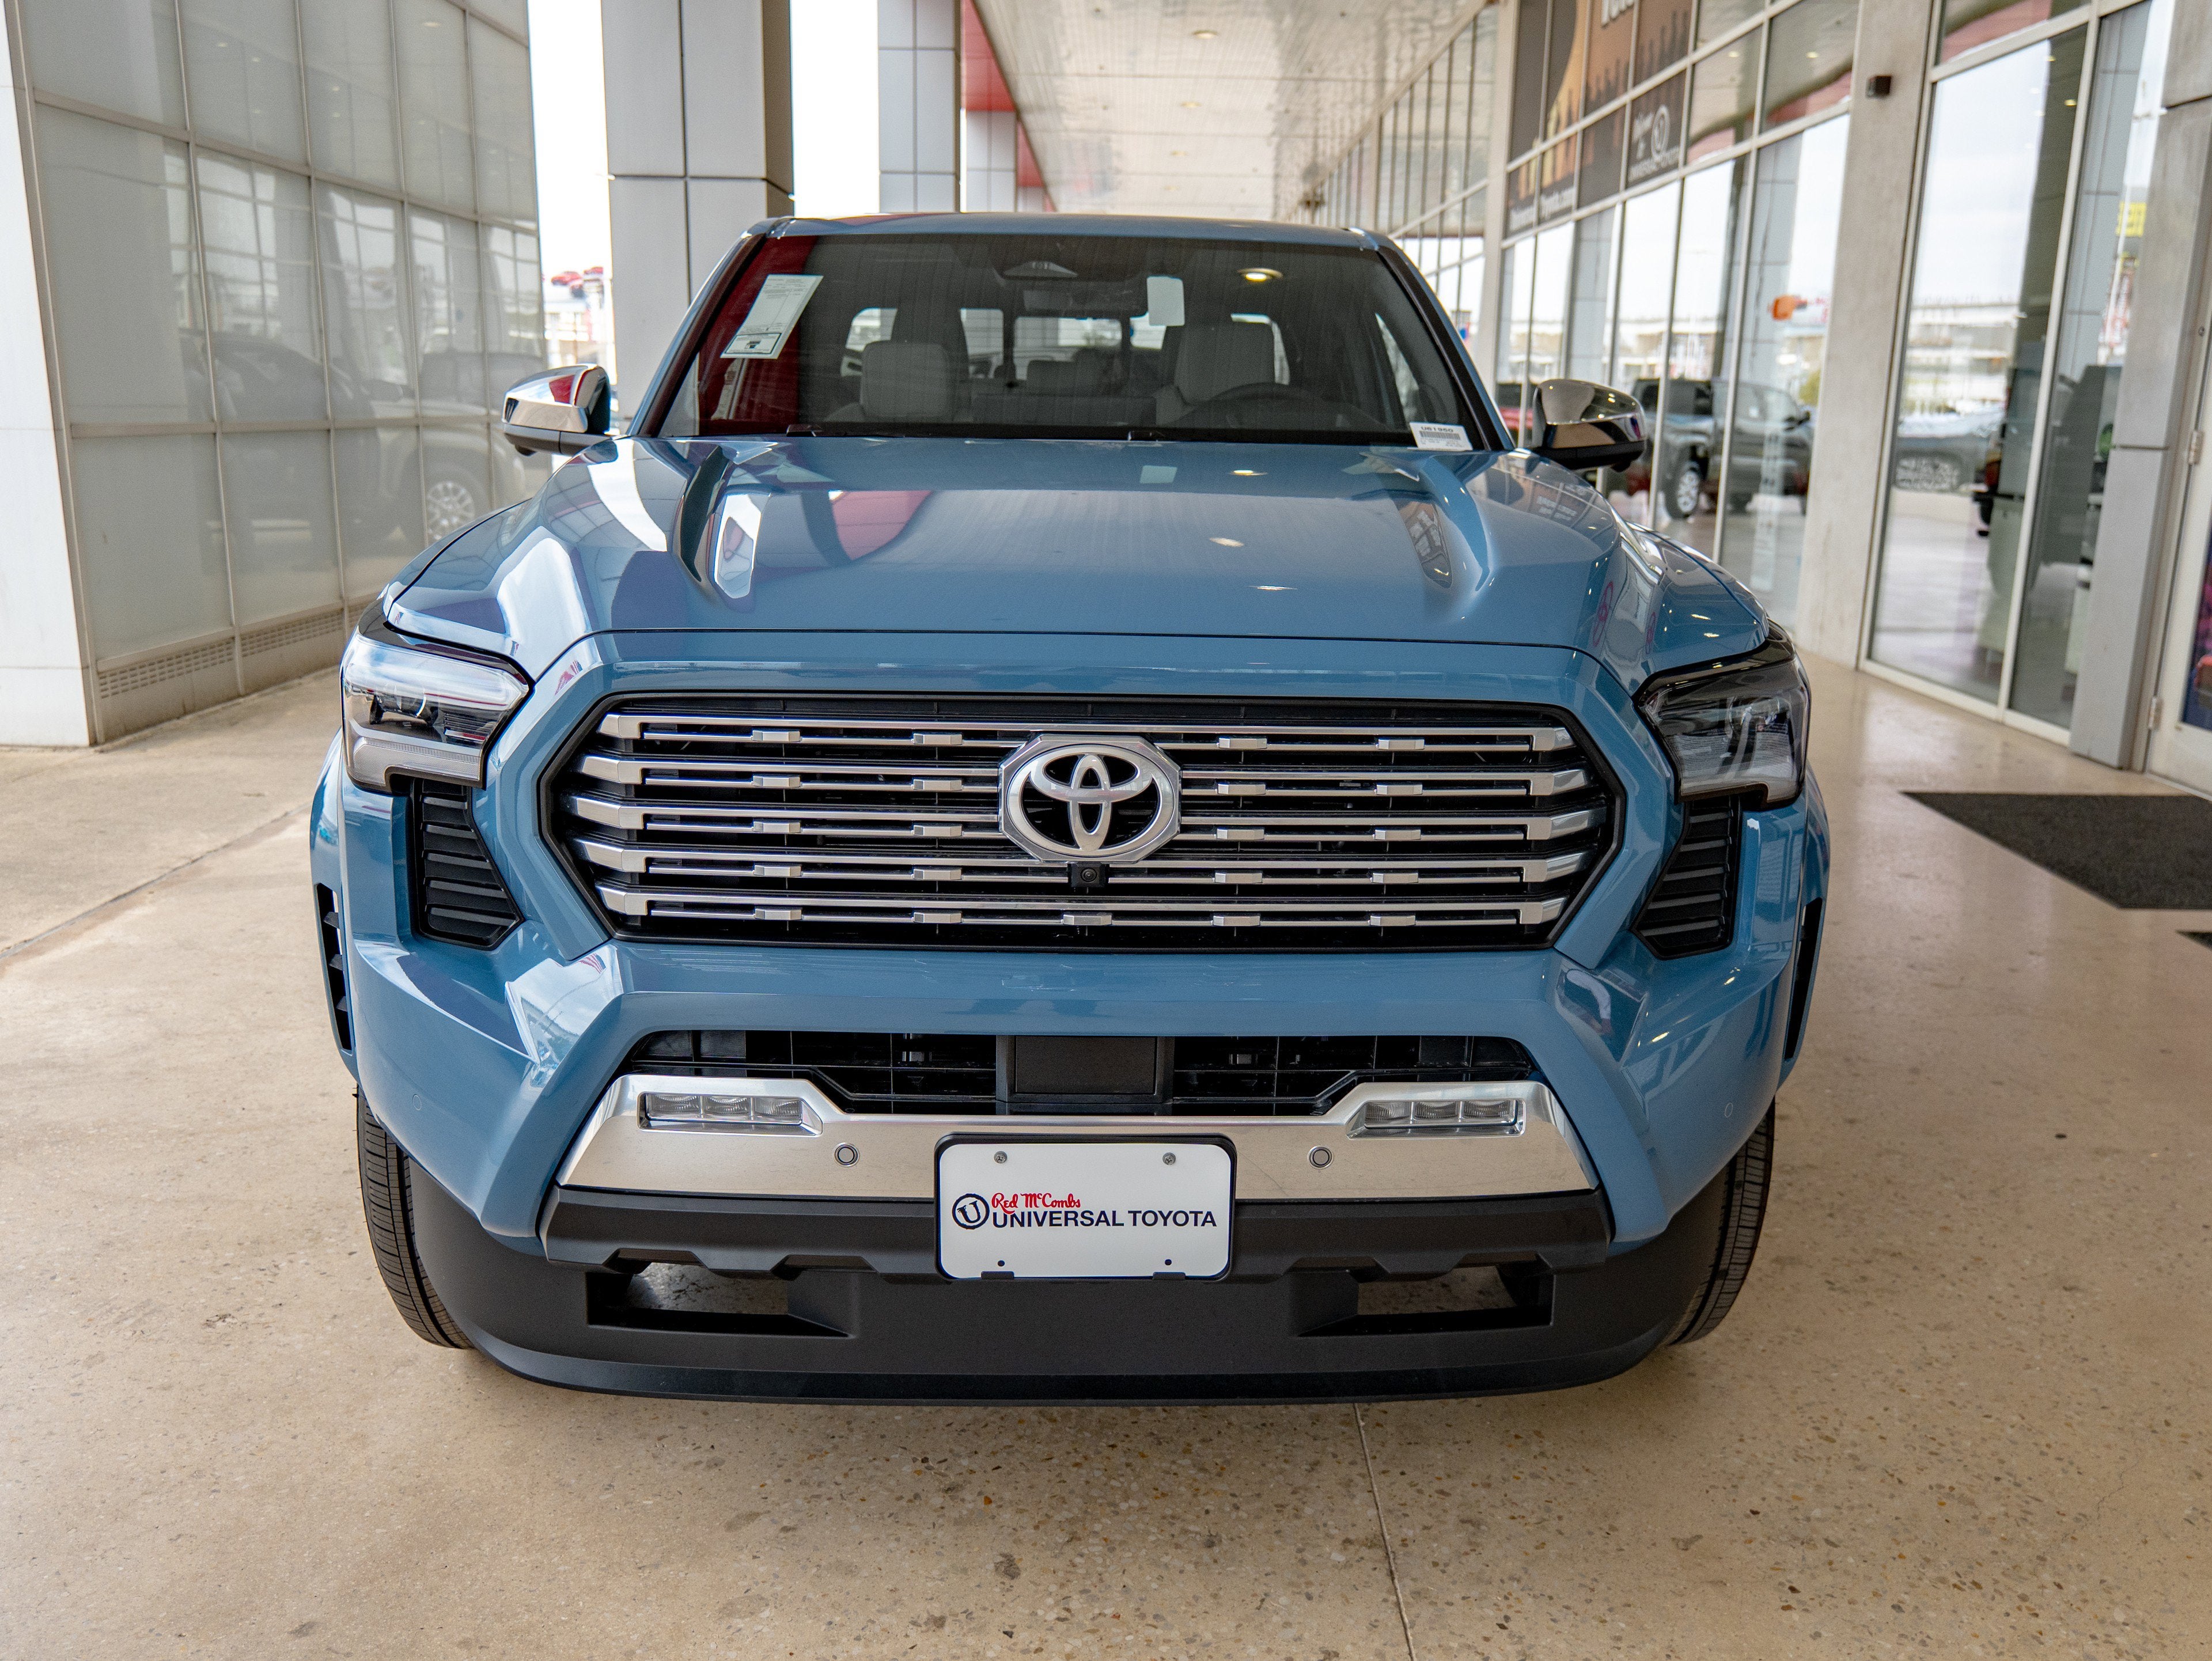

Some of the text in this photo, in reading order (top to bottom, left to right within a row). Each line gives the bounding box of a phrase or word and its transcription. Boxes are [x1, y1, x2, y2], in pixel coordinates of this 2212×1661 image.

[991, 1192, 1081, 1215] Red McCombs
[992, 1210, 1218, 1228] UNIVERSAL TOYOTA
